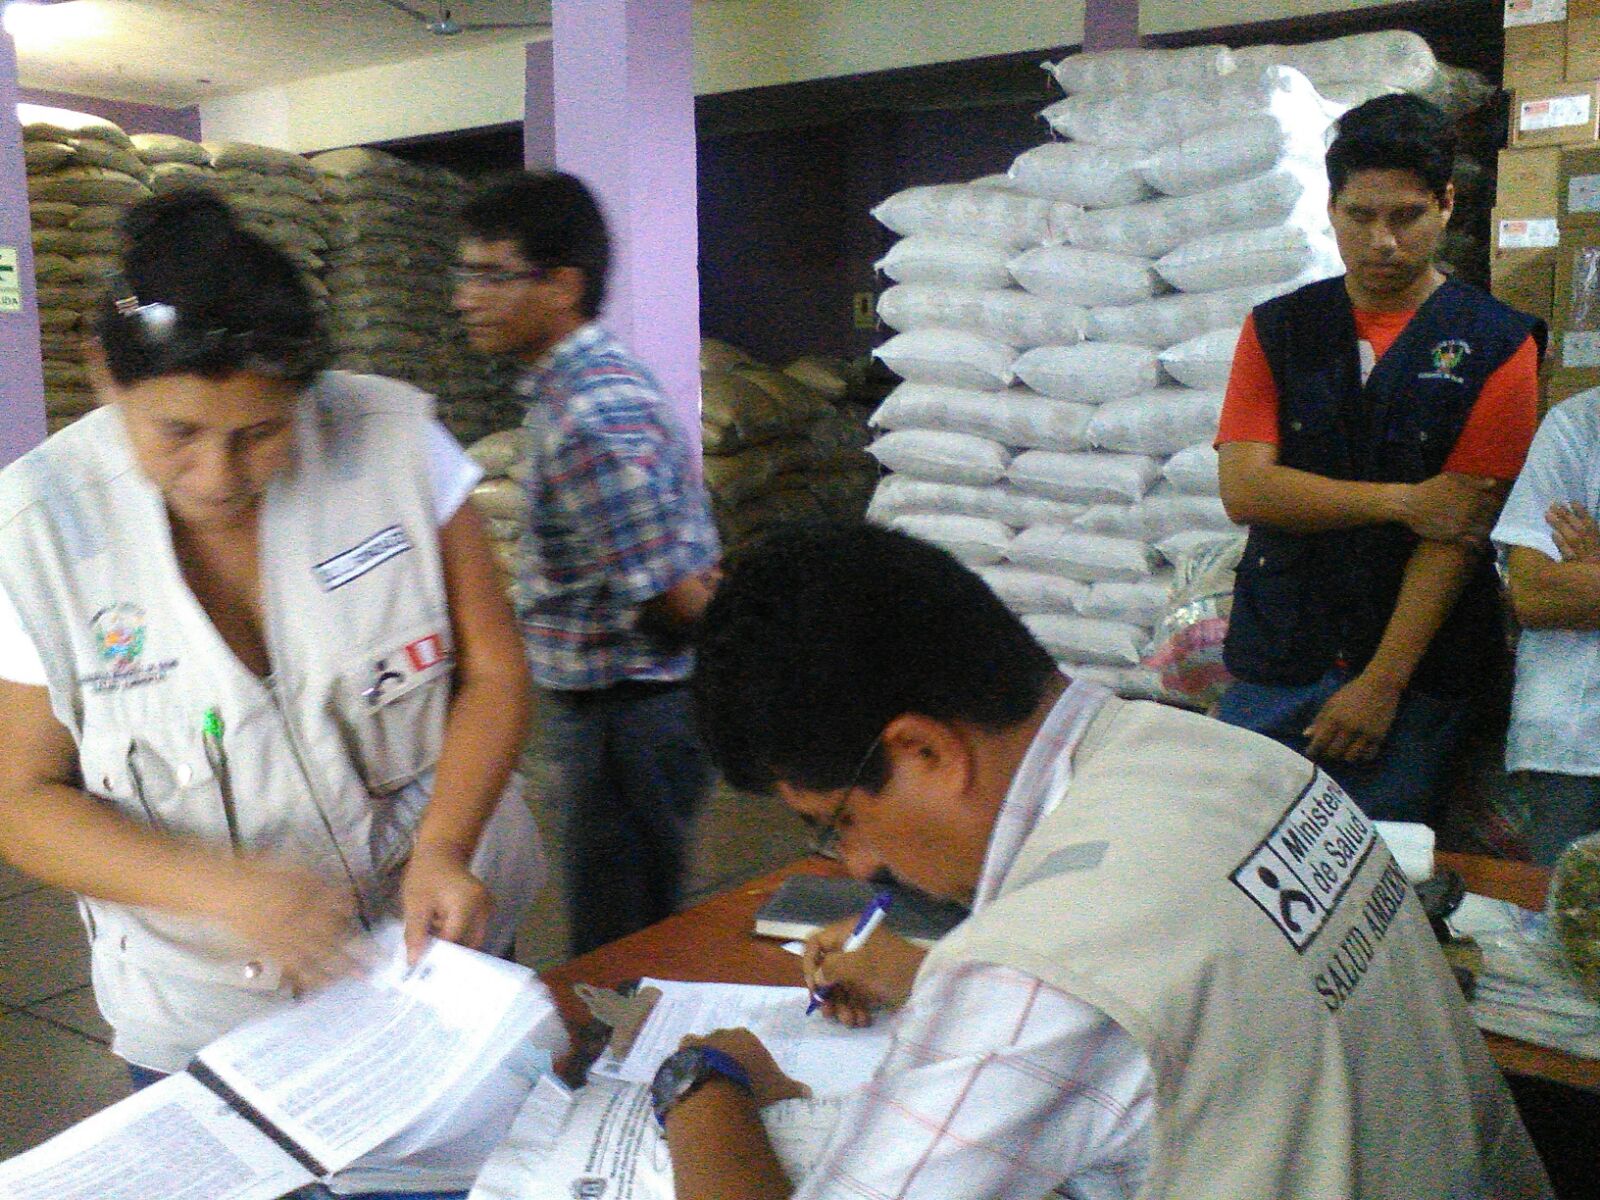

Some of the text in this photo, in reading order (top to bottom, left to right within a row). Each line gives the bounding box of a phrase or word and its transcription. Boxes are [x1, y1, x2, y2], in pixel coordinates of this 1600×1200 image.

[1309, 807, 1369, 893] de Salud
[1315, 926, 1374, 1010] SALUD
